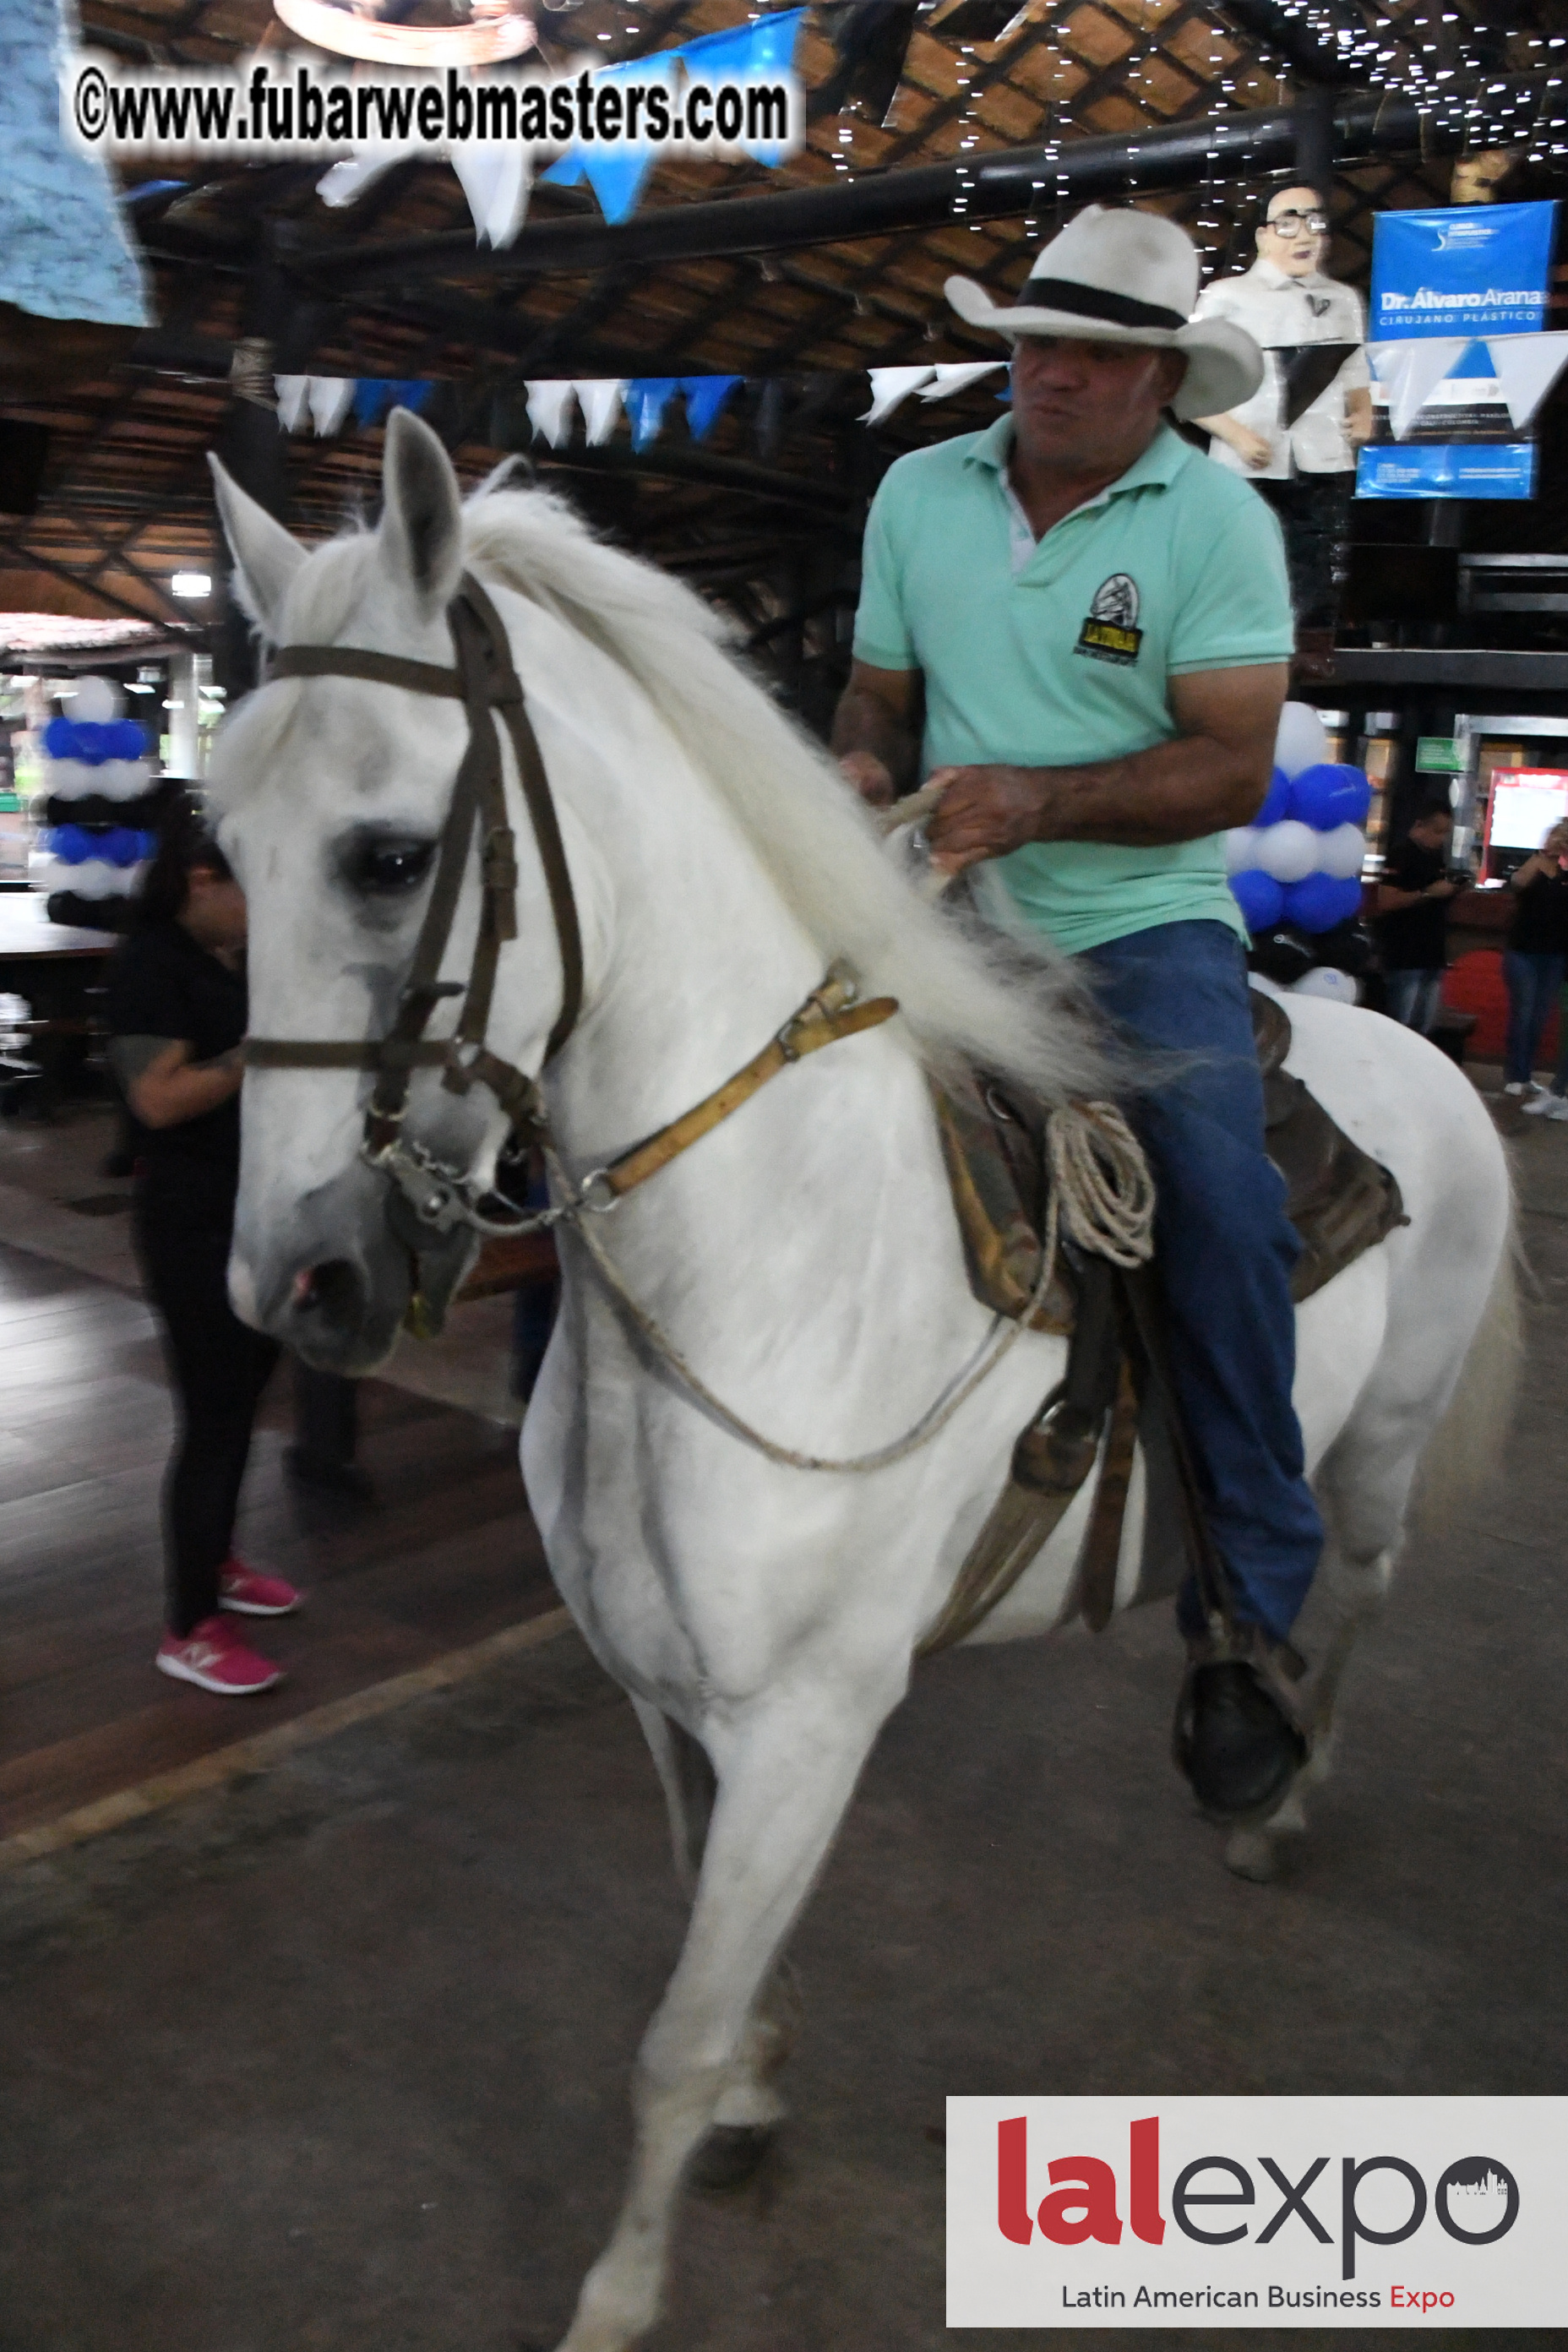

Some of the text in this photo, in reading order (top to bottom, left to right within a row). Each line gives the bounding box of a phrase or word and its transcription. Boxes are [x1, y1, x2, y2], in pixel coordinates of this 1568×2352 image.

[1381, 287, 1544, 311] Dr. Álvaro Arana
[1380, 310, 1536, 325] CIRUJANO PLÁSTICO
